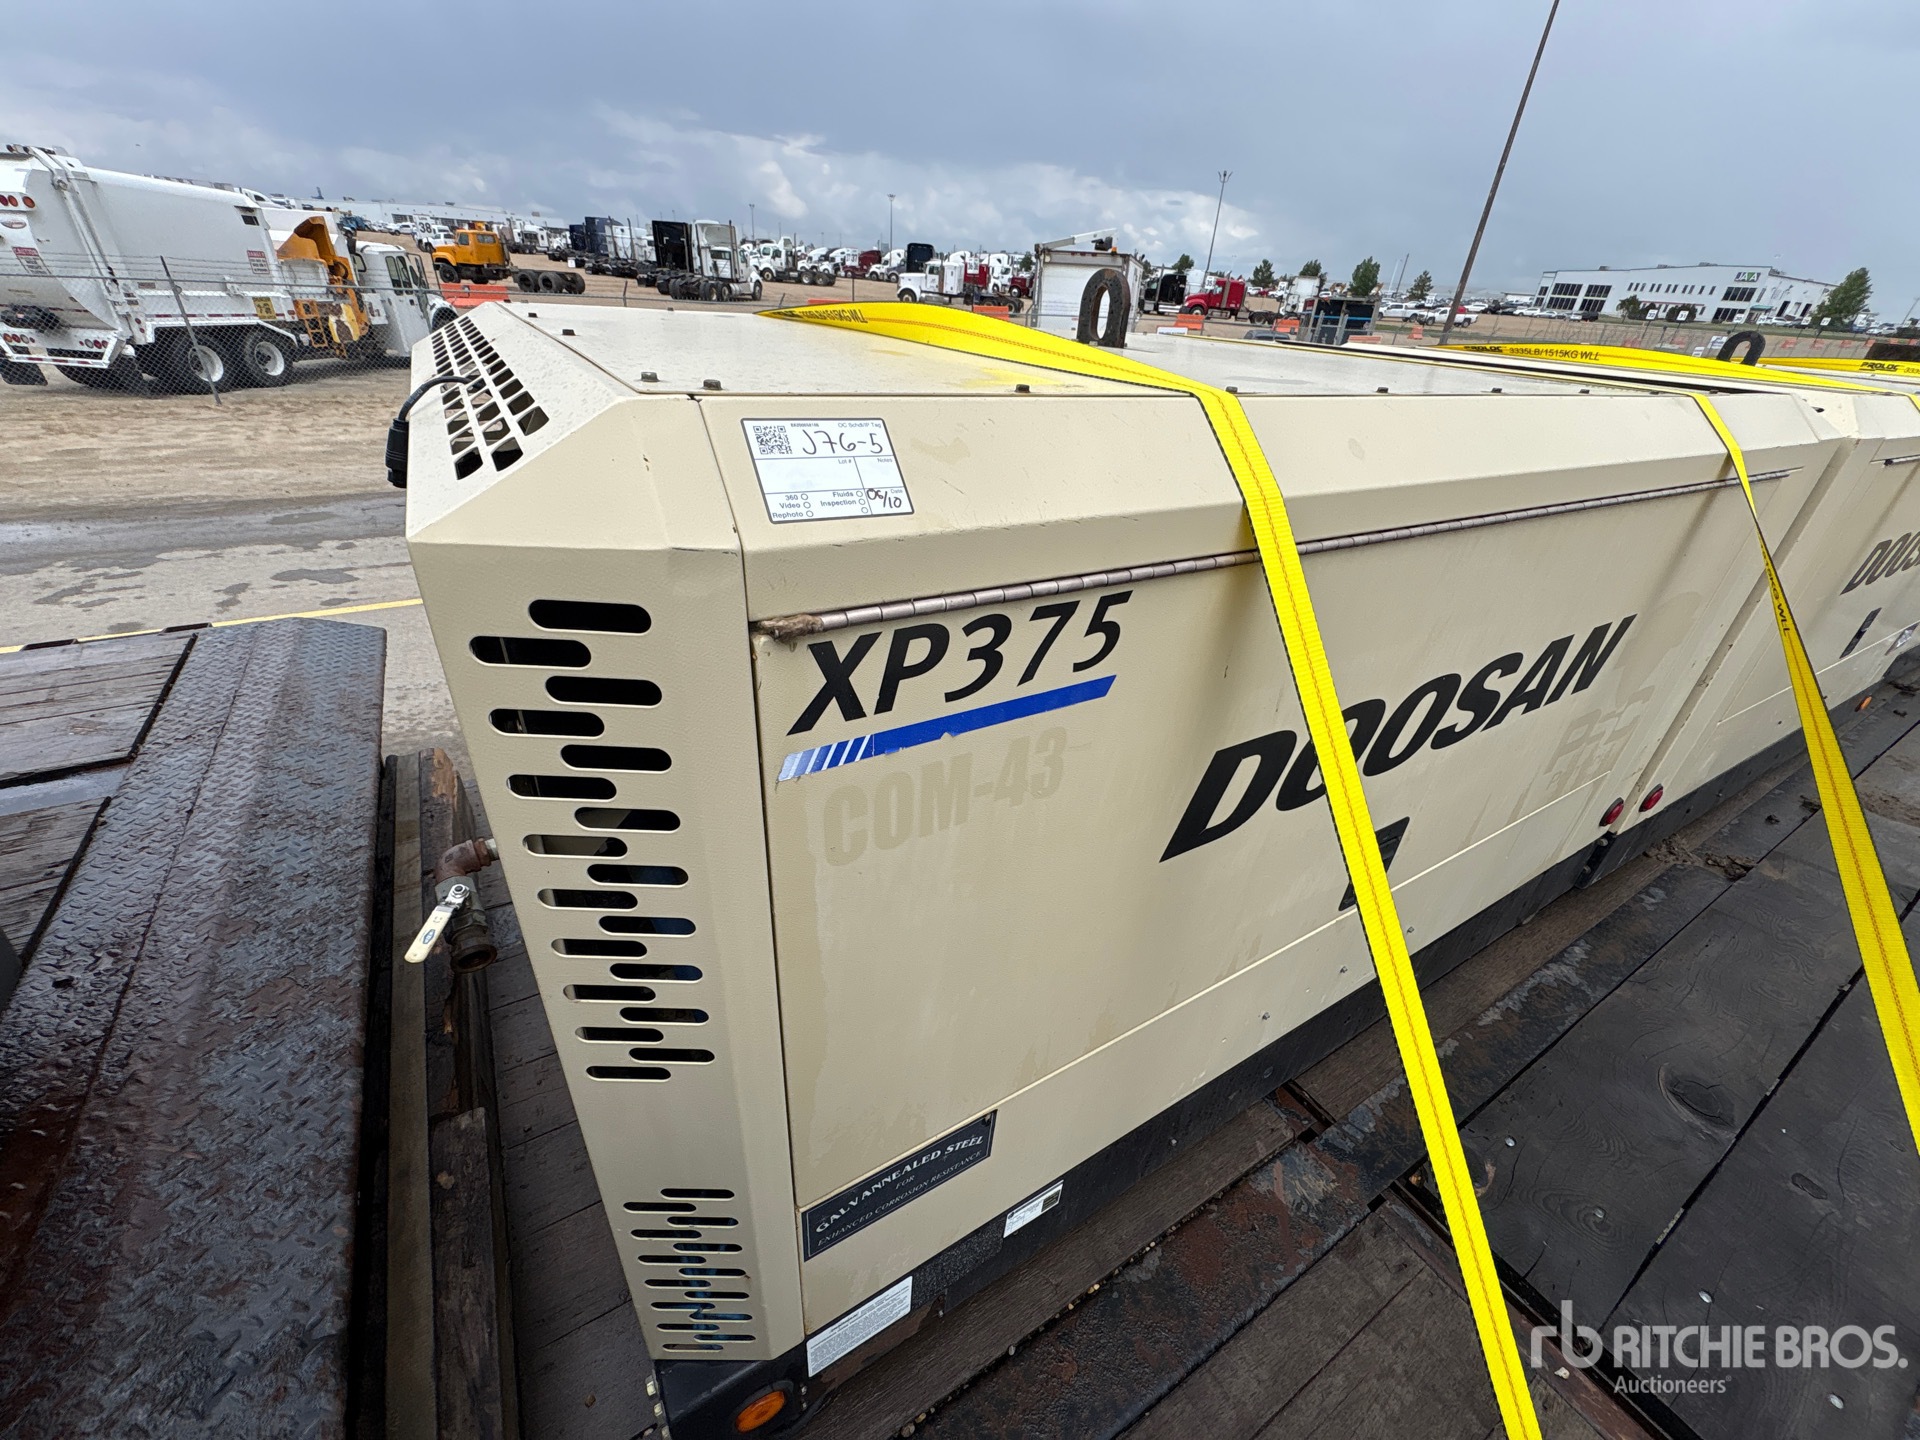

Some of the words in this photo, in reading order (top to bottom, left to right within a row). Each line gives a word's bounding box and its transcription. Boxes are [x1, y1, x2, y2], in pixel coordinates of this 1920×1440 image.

[419, 222, 431, 233] 38
[1509, 347, 1578, 359] 3335LB/1515KG
[1580, 351, 1600, 361] WLL
[1860, 362, 1900, 371] PROLOC
[1904, 367, 1920, 375] 333
[802, 429, 883, 455] J76-5
[820, 499, 857, 507] Inspection
[772, 511, 804, 519] Rephoto
[786, 590, 1134, 736] XP375
[1159, 614, 1638, 863] DOOSAN
[823, 726, 1067, 866] COM-43
[815, 1150, 942, 1233] GALVANNEALED
[944, 1135, 985, 1155] STEEL
[895, 1174, 915, 1190] FOR
[817, 1211, 874, 1246] ENHANCED
[875, 1180, 929, 1214] CORROSION
[930, 1150, 982, 1183] RESISTANCE
